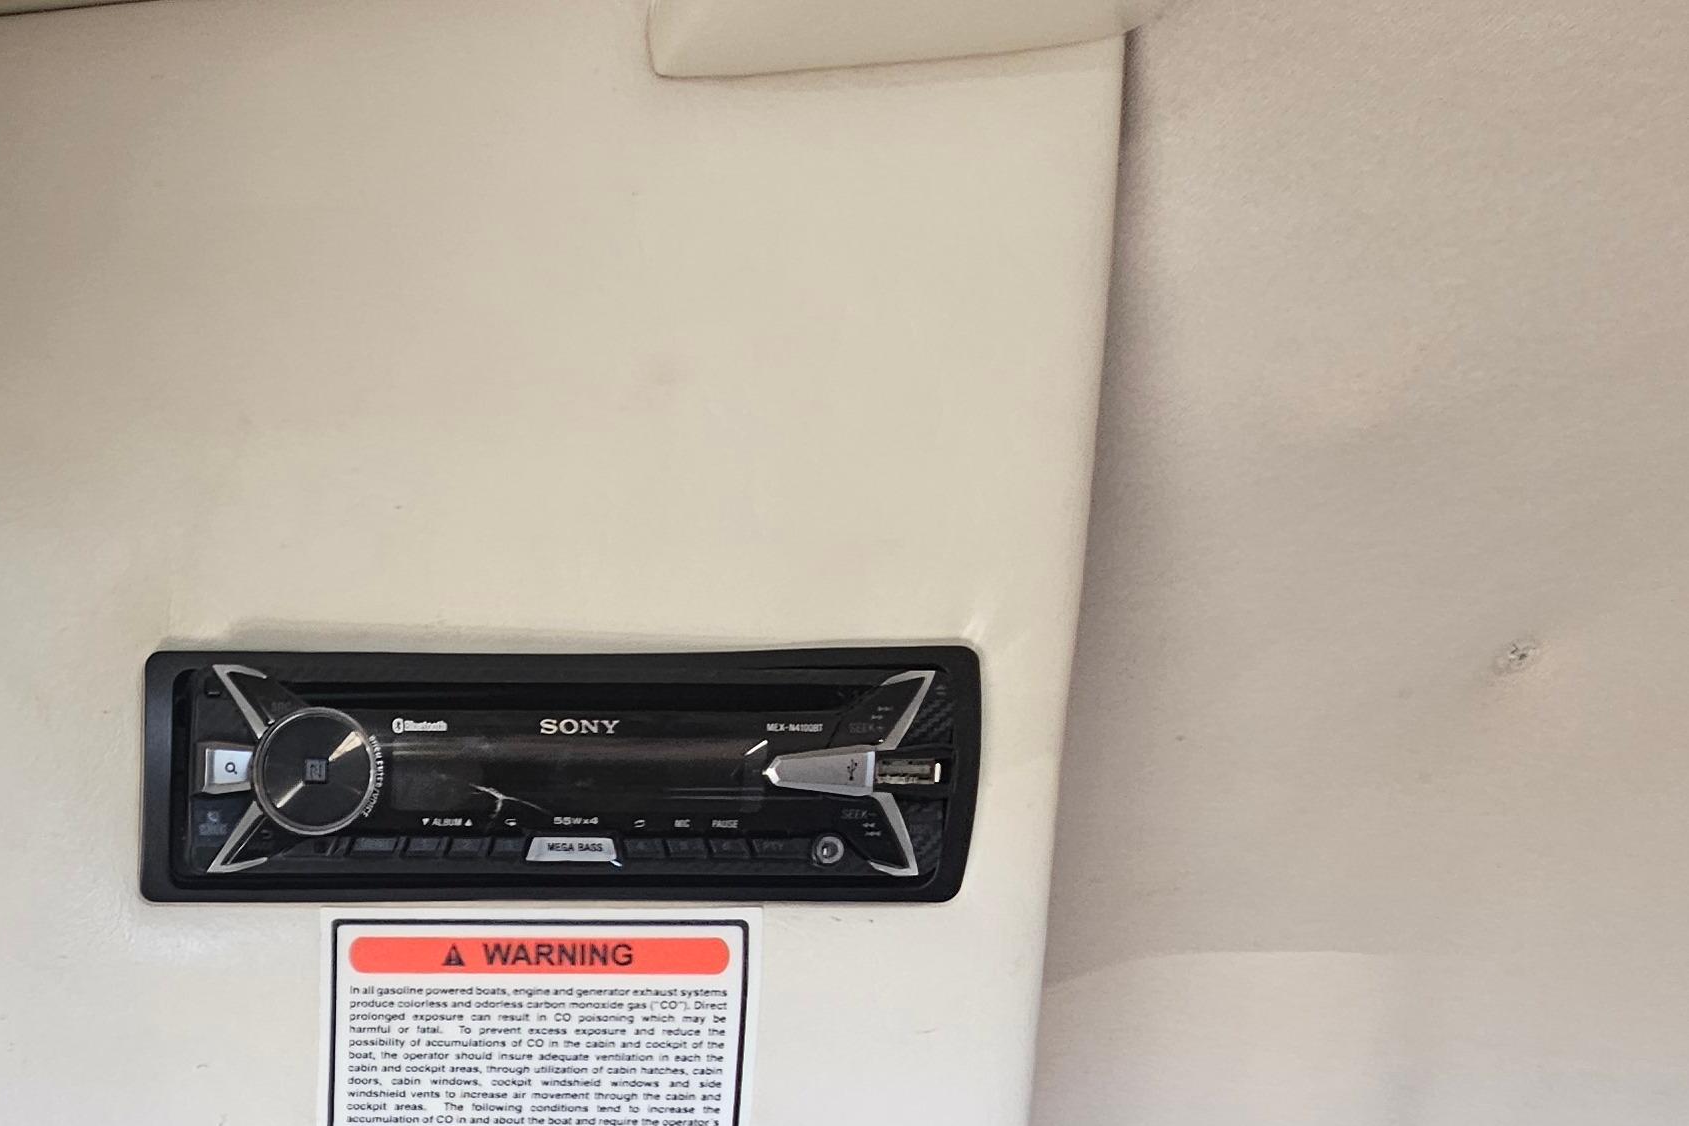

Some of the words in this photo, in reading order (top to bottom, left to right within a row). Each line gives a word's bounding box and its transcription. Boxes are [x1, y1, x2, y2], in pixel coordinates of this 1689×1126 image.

[539, 718, 621, 736] SONY
[431, 817, 463, 827] ALBUM
[674, 819, 690, 828] MIC
[712, 819, 739, 829] PAUSE
[547, 842, 574, 852] MEGA
[577, 842, 604, 853] BASS
[483, 943, 634, 966] WARNING
[350, 986, 360, 995] In
[362, 986, 374, 995] all
[377, 986, 423, 997] gasoline
[426, 987, 473, 997] powered
[476, 987, 510, 996] boats,
[513, 988, 550, 998] engine
[552, 988, 573, 996] and
[576, 989, 630, 998] generator
[632, 989, 678, 997] exhaust
[680, 989, 728, 998] systems
